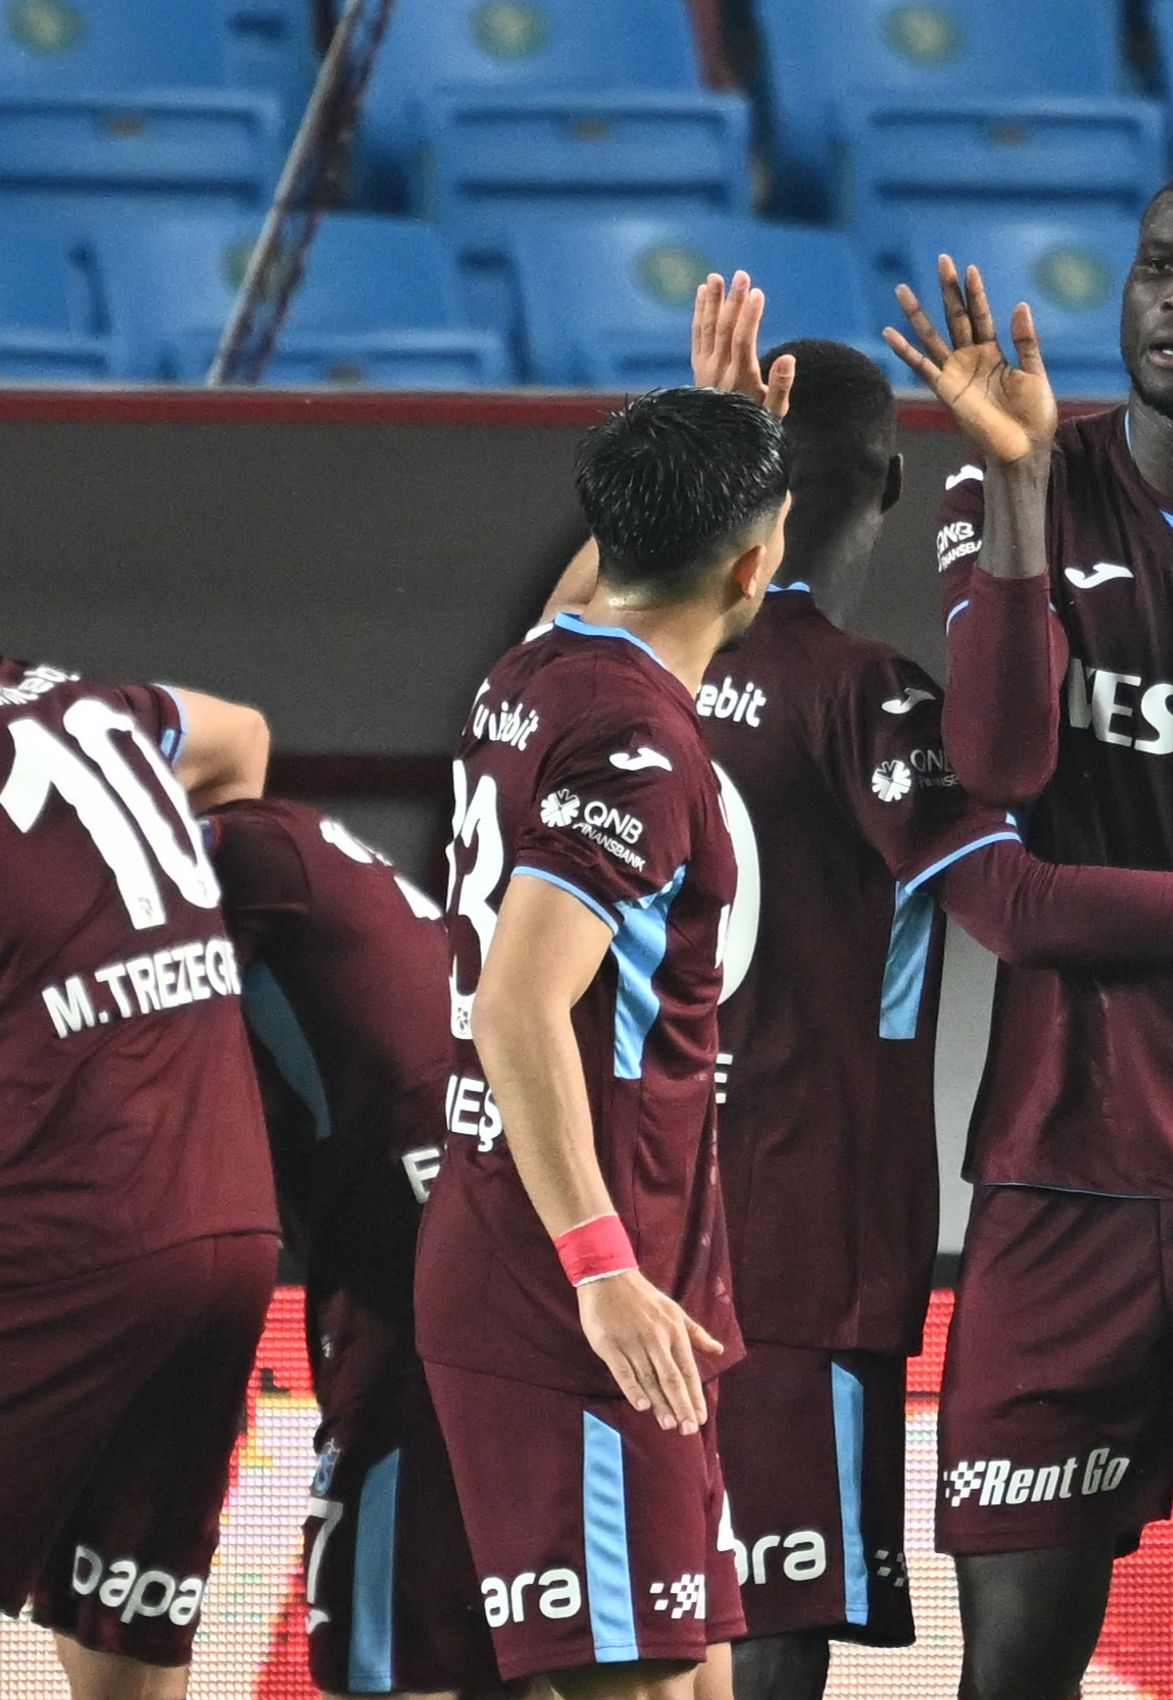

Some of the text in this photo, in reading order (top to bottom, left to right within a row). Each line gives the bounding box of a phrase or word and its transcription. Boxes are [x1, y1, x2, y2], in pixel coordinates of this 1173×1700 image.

[0, 698, 222, 931] 10
[583, 800, 644, 845] QNB
[979, 1447, 1131, 1507] Rent Go
